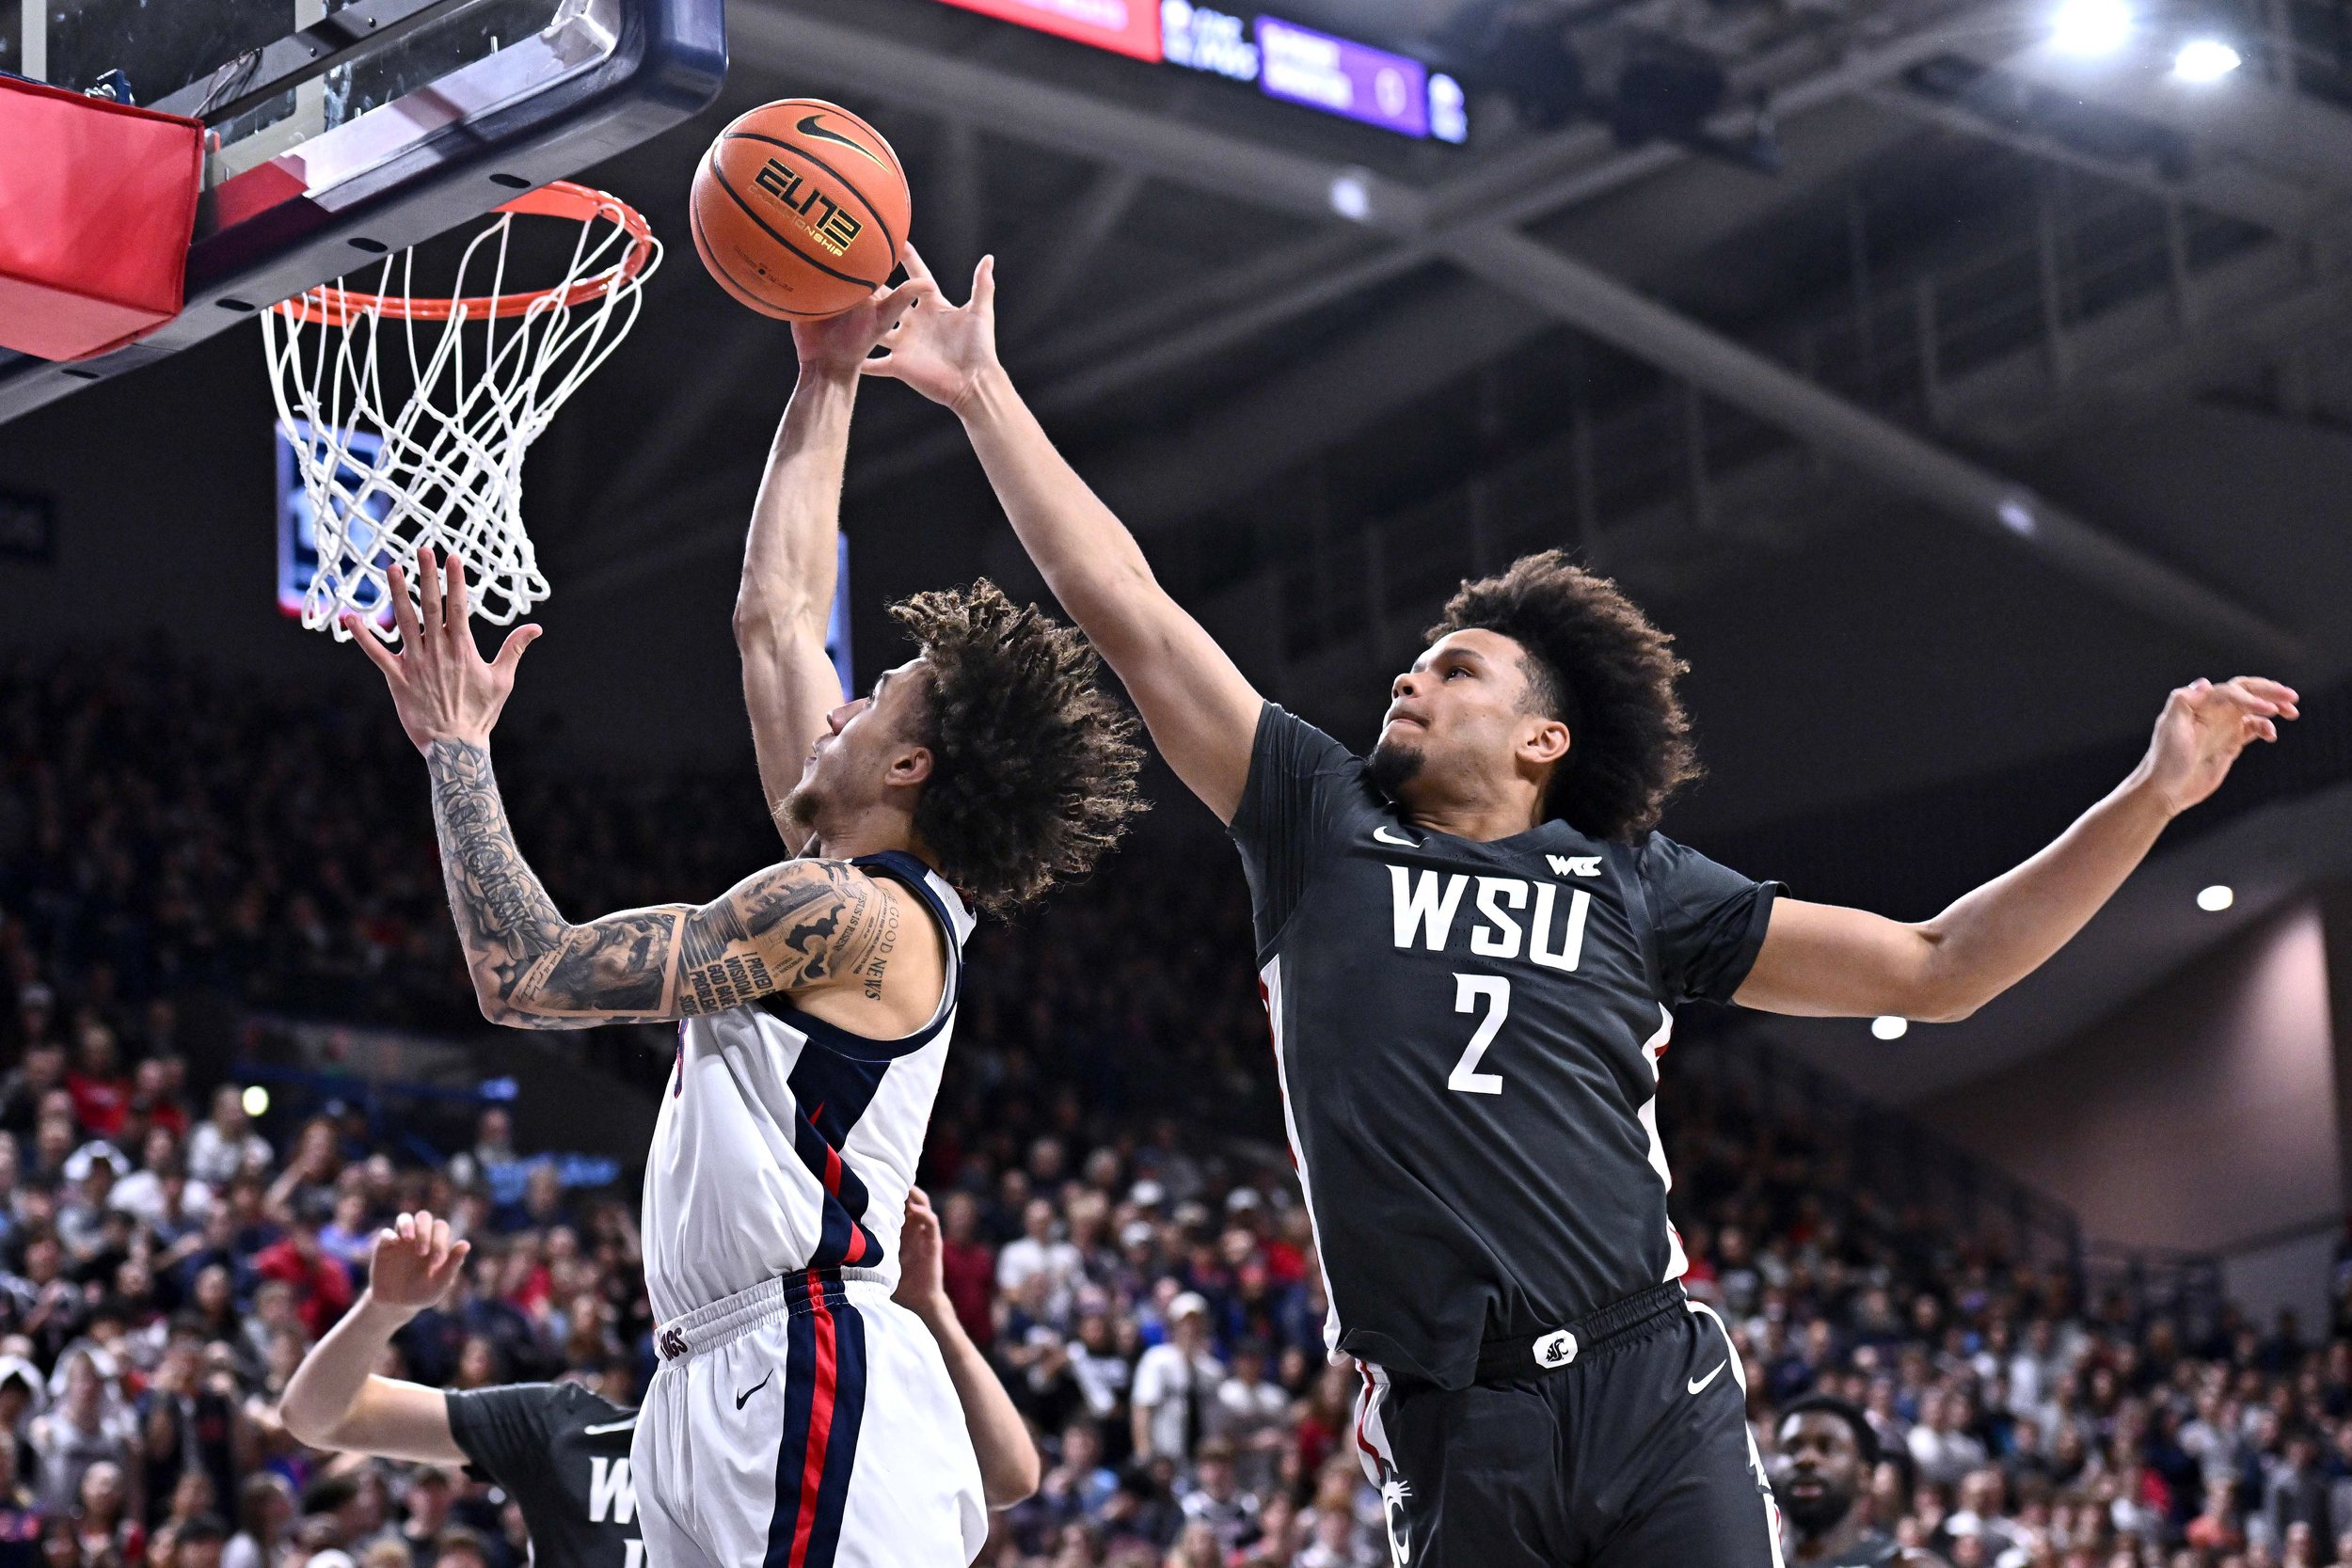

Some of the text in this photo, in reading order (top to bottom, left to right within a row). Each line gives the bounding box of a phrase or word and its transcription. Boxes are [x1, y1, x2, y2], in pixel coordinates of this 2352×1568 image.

[755, 158, 863, 251] ELITE
[1545, 854, 1602, 877] WCC
[833, 889, 867, 951] JESUS IS RISEN
[880, 906, 899, 954] GOOD
[1385, 863, 1592, 973] WSU
[707, 963, 729, 986] GOD
[723, 955, 755, 997] WISDOM
[744, 957, 774, 990] PRAYED
[863, 957, 887, 1001] NEWS
[715, 985, 739, 1007] GAVE
[1447, 972, 1511, 1095] 2
